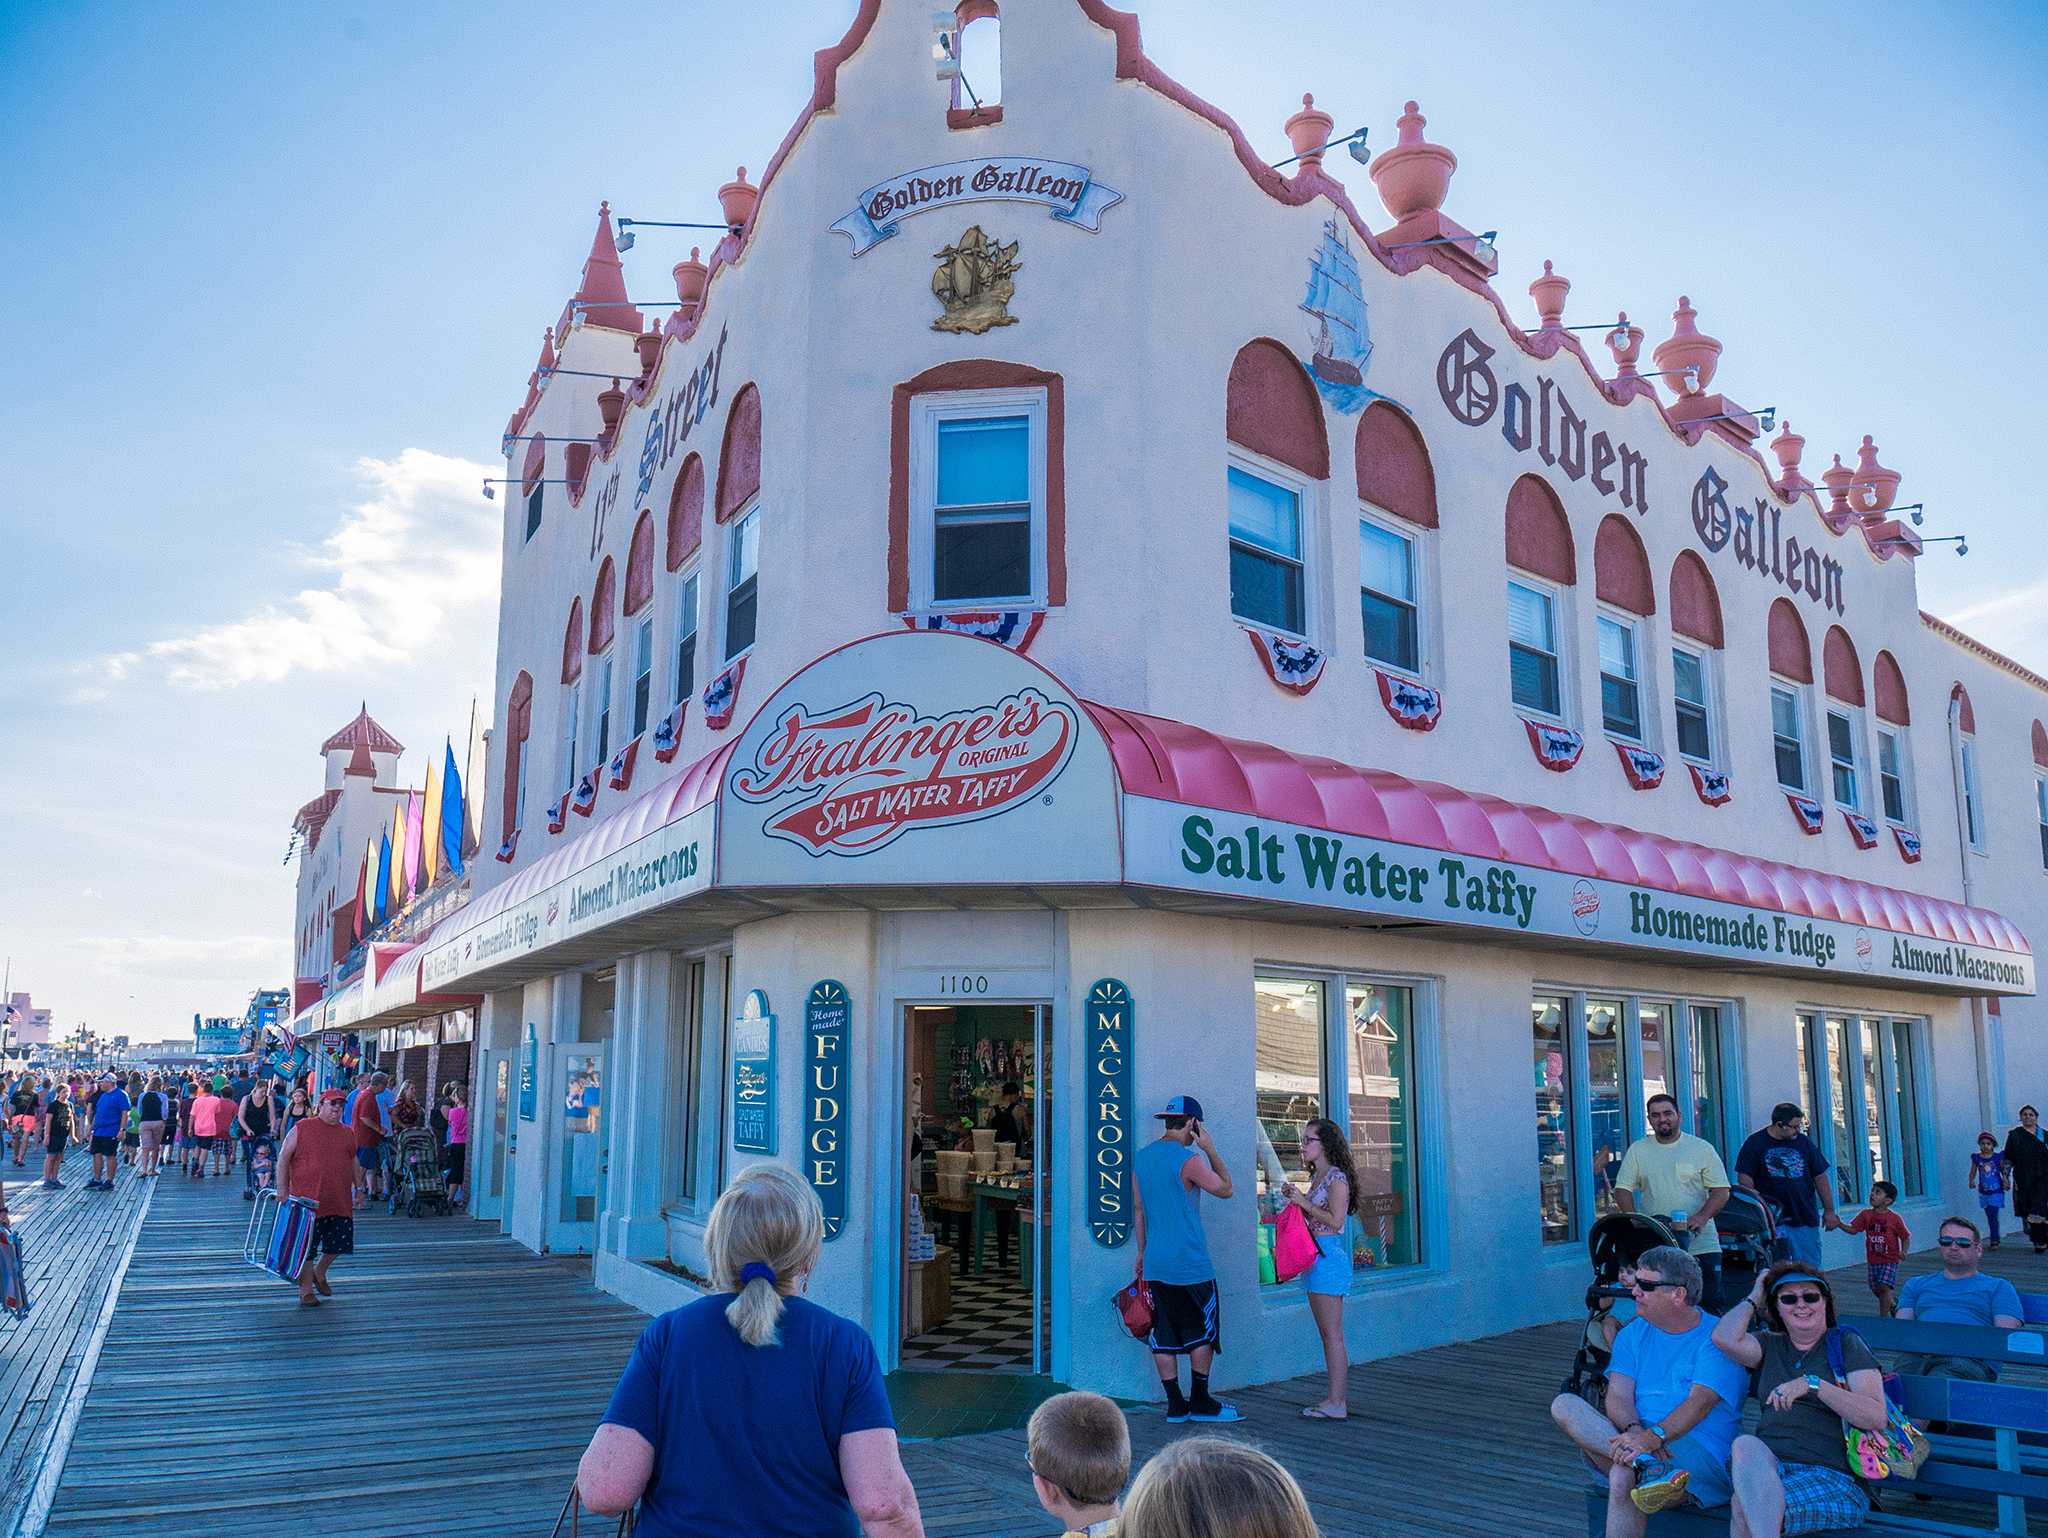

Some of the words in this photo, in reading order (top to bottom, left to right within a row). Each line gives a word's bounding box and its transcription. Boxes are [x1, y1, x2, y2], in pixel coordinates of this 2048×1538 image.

[867, 172, 965, 221] Golden
[971, 164, 1085, 202] Galleon
[634, 317, 729, 511] Street
[1436, 327, 1649, 516] Golden
[1692, 465, 1845, 618] Galleon
[739, 696, 1041, 795] Fralinger's
[958, 741, 1030, 768] ORIGINAL
[815, 797, 873, 836] SALT
[876, 784, 951, 817] WATER
[957, 769, 1027, 806] TAFFY
[568, 869, 614, 924] Almond
[616, 841, 698, 905] Macaroons
[1181, 815, 1286, 884] Salt
[1295, 833, 1429, 904] Water
[1438, 857, 1538, 928] Taffy
[476, 921, 512, 961] Homemade
[513, 911, 538, 949] Fudge
[1629, 891, 1768, 951] Homemade
[1772, 915, 1836, 968] Fudge
[1891, 936, 1953, 976] Almond
[1954, 947, 2025, 985] Macaroons
[941, 975, 988, 993] 1100
[324, 1033, 341, 1042] ATM
[738, 1121, 766, 1140] TAFFY
[811, 1034, 840, 1186] FUDGE
[1097, 1012, 1123, 1213] MACAROONS
